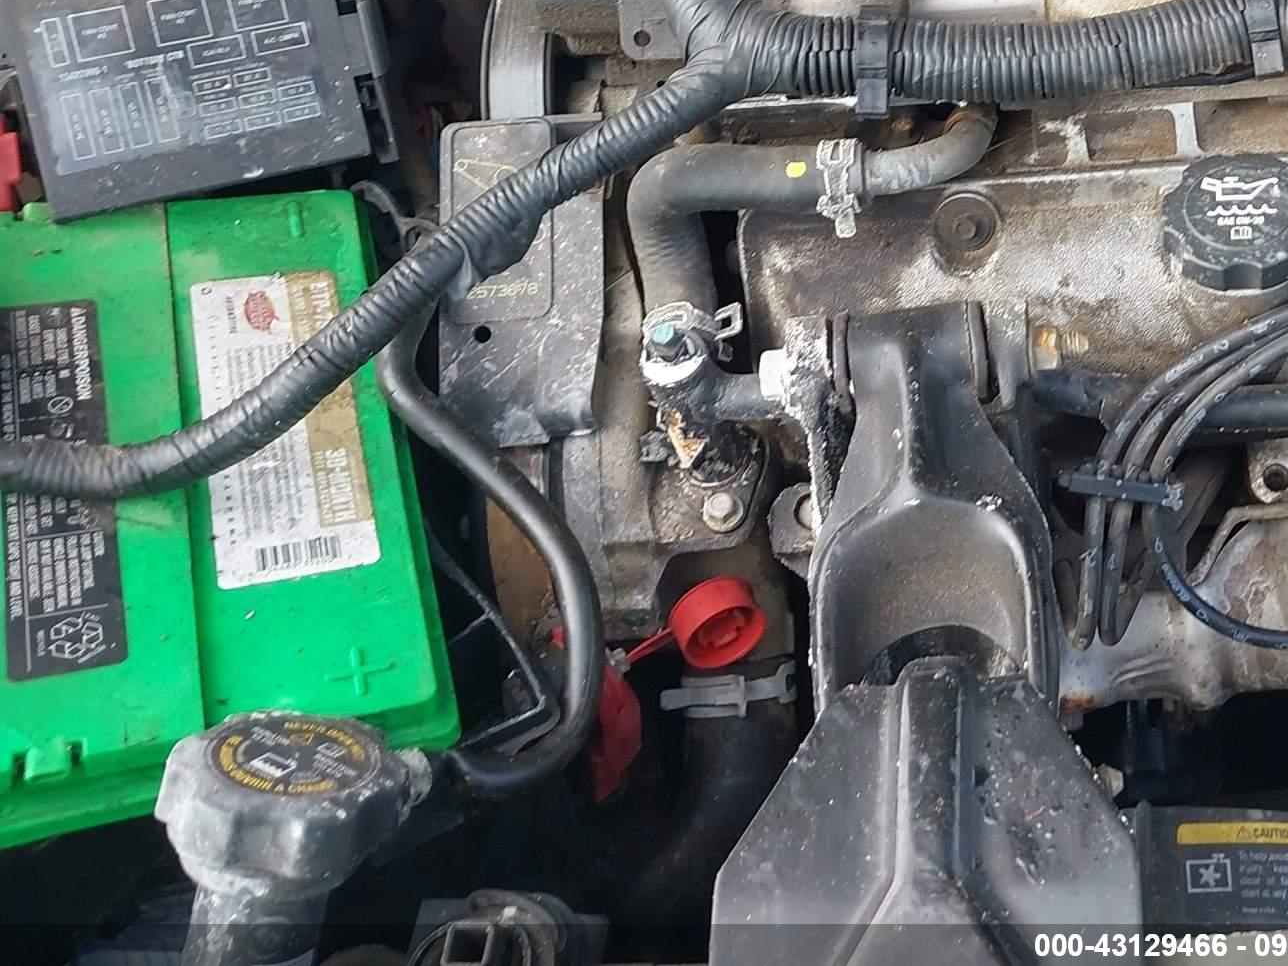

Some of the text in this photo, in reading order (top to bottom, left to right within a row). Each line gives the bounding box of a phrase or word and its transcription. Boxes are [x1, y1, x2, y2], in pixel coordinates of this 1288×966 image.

[71, 315, 92, 401] DANGER POISON
[323, 447, 359, 524] 30-MONTH
